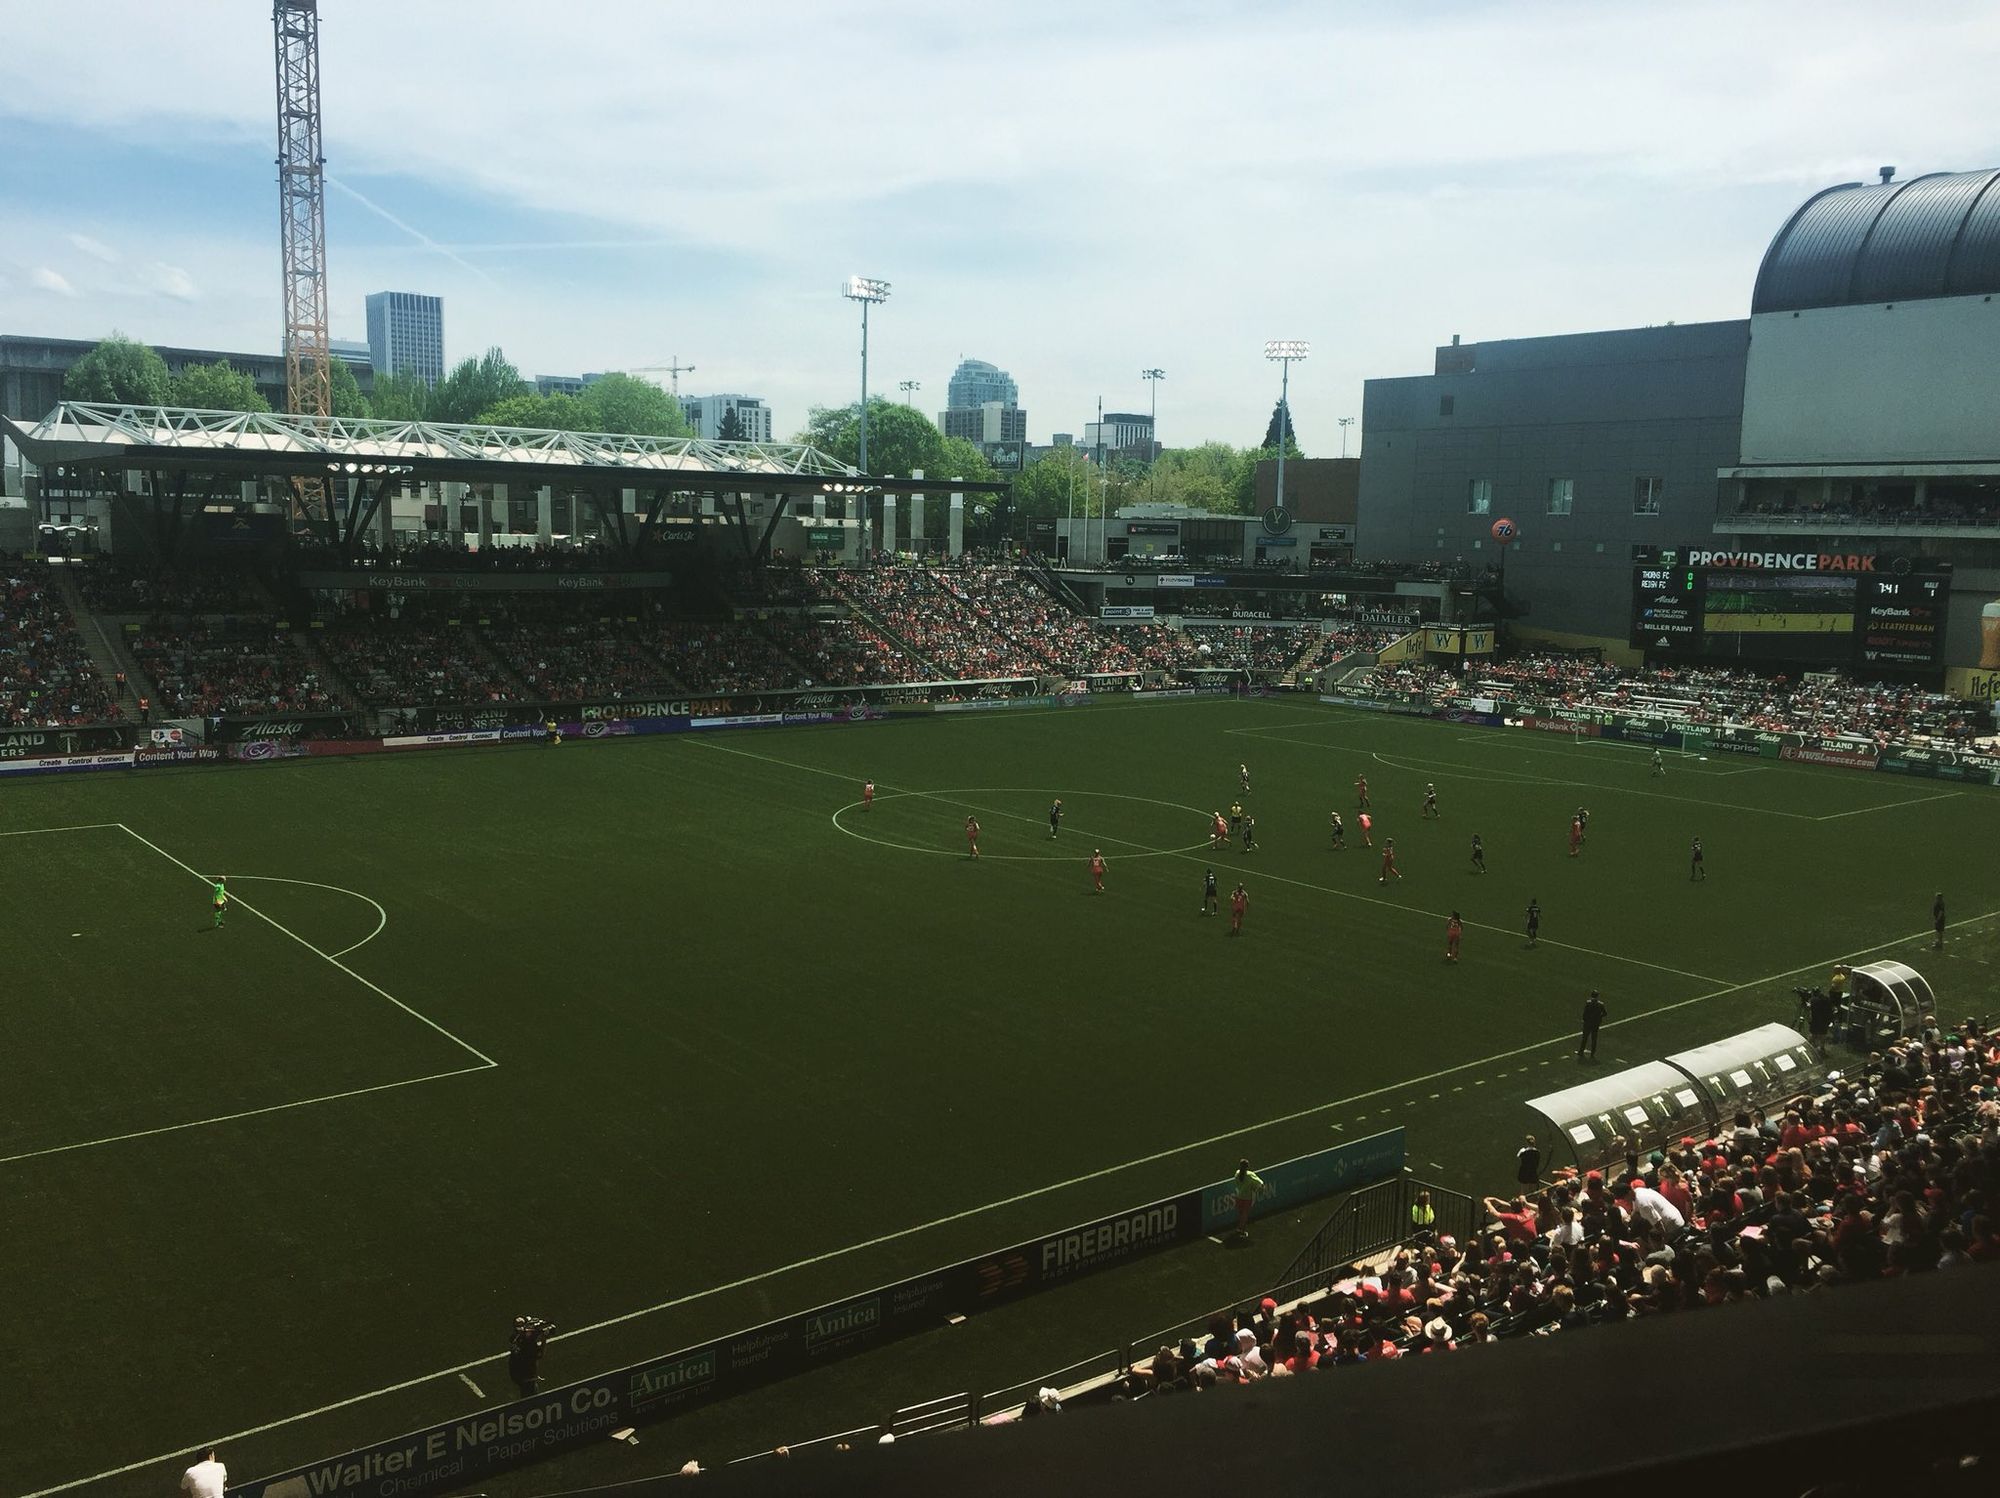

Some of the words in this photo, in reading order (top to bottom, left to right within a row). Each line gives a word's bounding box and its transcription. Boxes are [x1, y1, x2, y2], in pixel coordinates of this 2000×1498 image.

[1498, 524, 1513, 537] 76
[1662, 571, 1670, 580] FC
[369, 576, 427, 589] KeyBank
[558, 576, 604, 589] KeyBank
[1658, 581, 1666, 589] FC
[1232, 610, 1272, 619] DURACELL
[1871, 606, 1911, 617] KeyBank
[1360, 613, 1412, 625] DAIMLER
[1644, 623, 1670, 631] MILLER
[1671, 625, 1694, 633] PAINT
[1880, 622, 1935, 632] LEATHERMAN
[880, 686, 932, 699] PORLAND
[794, 693, 835, 706] Alaska
[435, 709, 508, 721] PORLAND
[581, 701, 689, 720] PRODENCE
[241, 720, 304, 736] Alaska
[1535, 719, 1569, 732] KeyBank
[1625, 717, 1649, 728] Alaska
[1671, 723, 1711, 733] PORTLAND
[503, 728, 531, 739] Content
[532, 727, 547, 738] Your
[1630, 729, 1664, 738] PROVIDECE
[1754, 731, 1782, 743] Alaska
[138, 750, 175, 762] Content
[176, 749, 196, 760] Your
[198, 748, 221, 760] Way.
[1797, 751, 1876, 767] NWSLsoccer.com
[1898, 748, 1931, 760] Alaska
[39, 758, 61, 767] Create
[67, 757, 92, 765] Control
[97, 755, 125, 764] Connect
[1042, 1204, 1178, 1271] FIREBRAND
[811, 1306, 876, 1337] Amica
[731, 1330, 789, 1356] Helpfulness
[731, 1344, 773, 1371] Insured
[637, 1358, 711, 1397] Amica
[308, 1446, 418, 1496] Walter
[426, 1430, 447, 1461] E
[456, 1402, 563, 1450] Nelson
[570, 1387, 618, 1415] Co.
[380, 1455, 464, 1497] Chemical
[487, 1437, 537, 1464] Paper
[543, 1411, 619, 1446] Solutions
